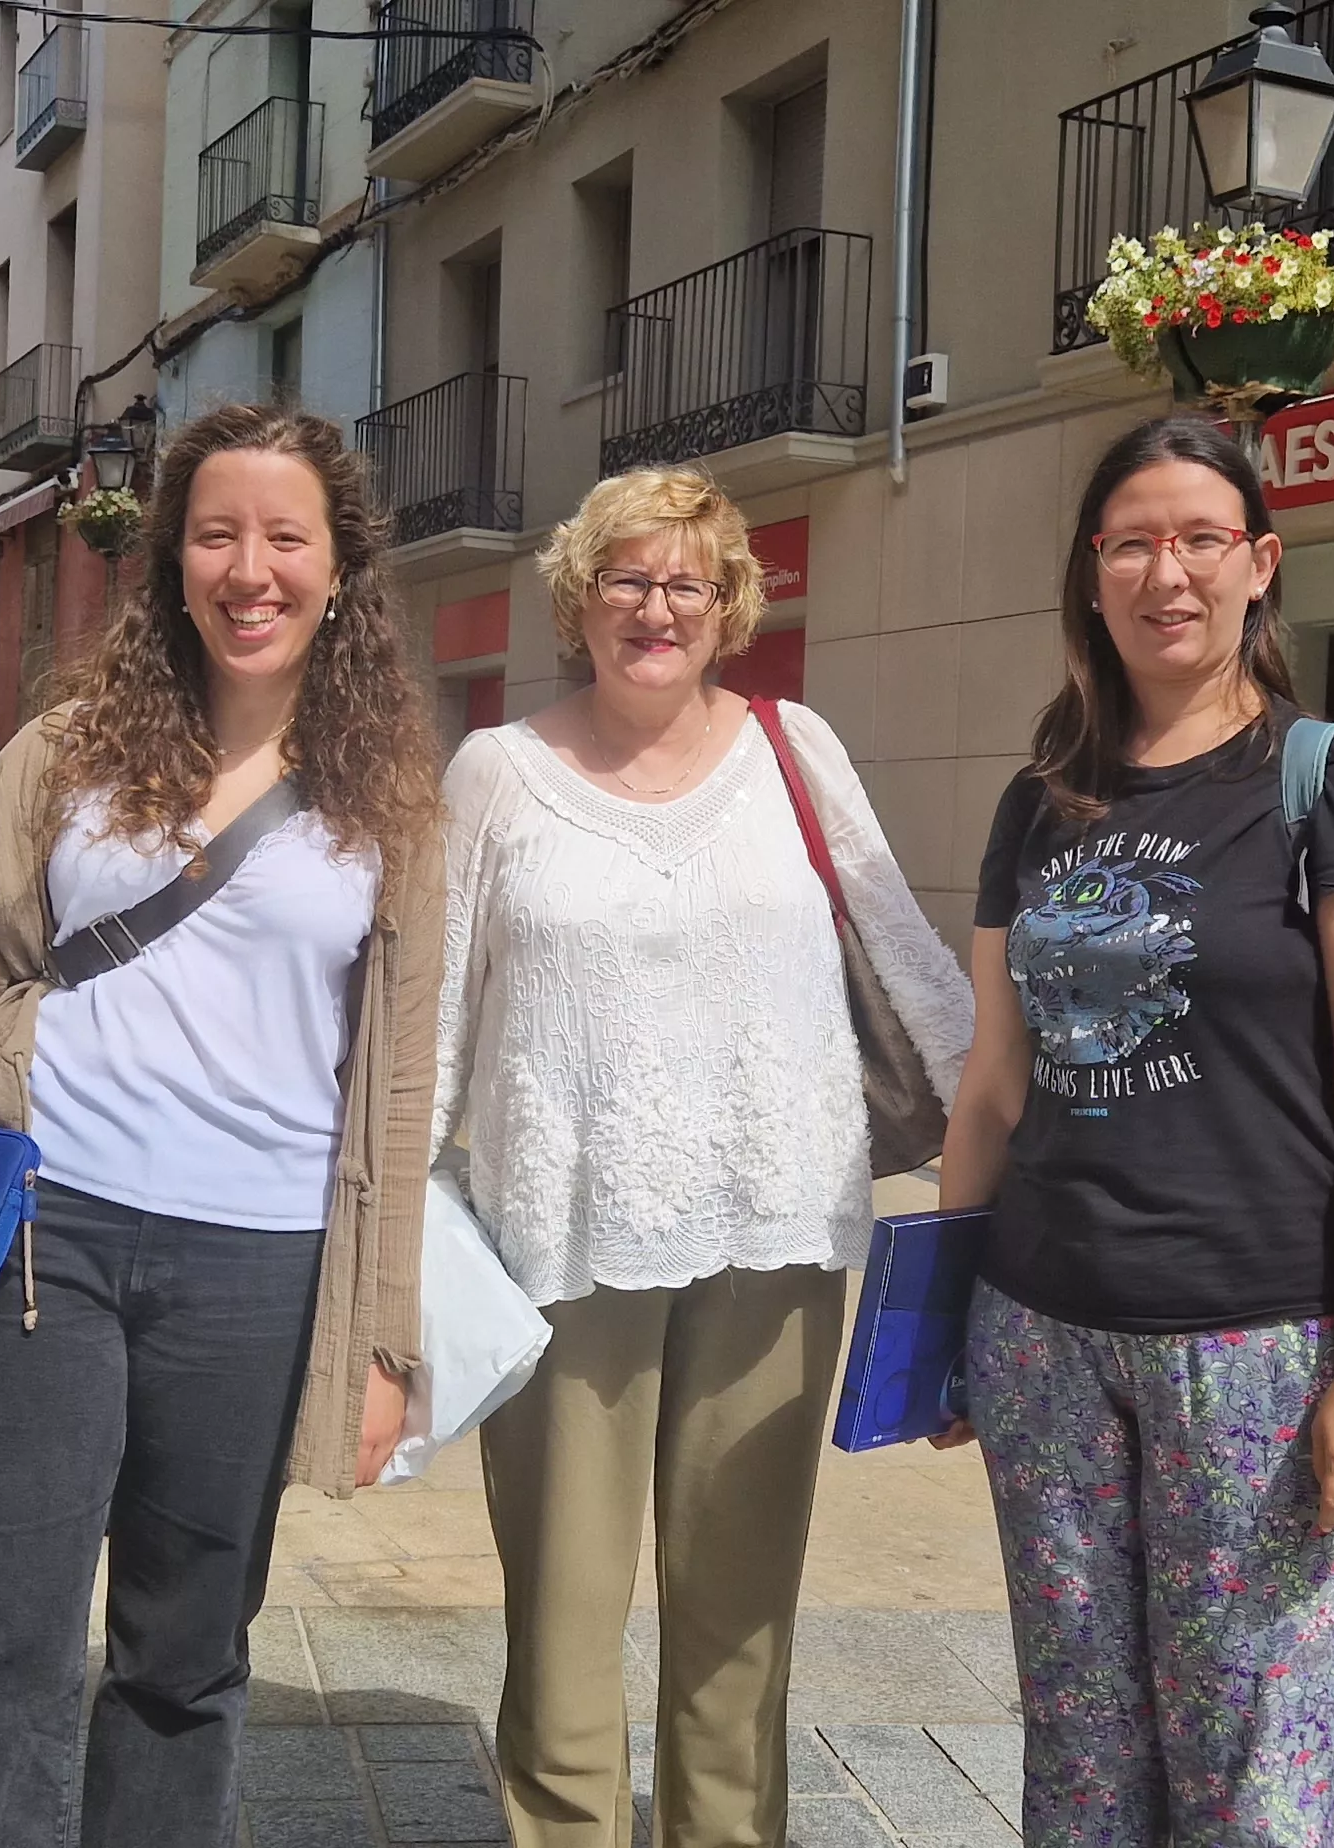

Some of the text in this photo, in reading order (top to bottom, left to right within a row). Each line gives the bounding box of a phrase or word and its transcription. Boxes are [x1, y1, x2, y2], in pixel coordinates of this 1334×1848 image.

[1040, 844, 1085, 883] SAVE
[1094, 832, 1127, 858] THE
[1090, 1067, 1136, 1099] LIVE
[1144, 1051, 1202, 1092] HERE
